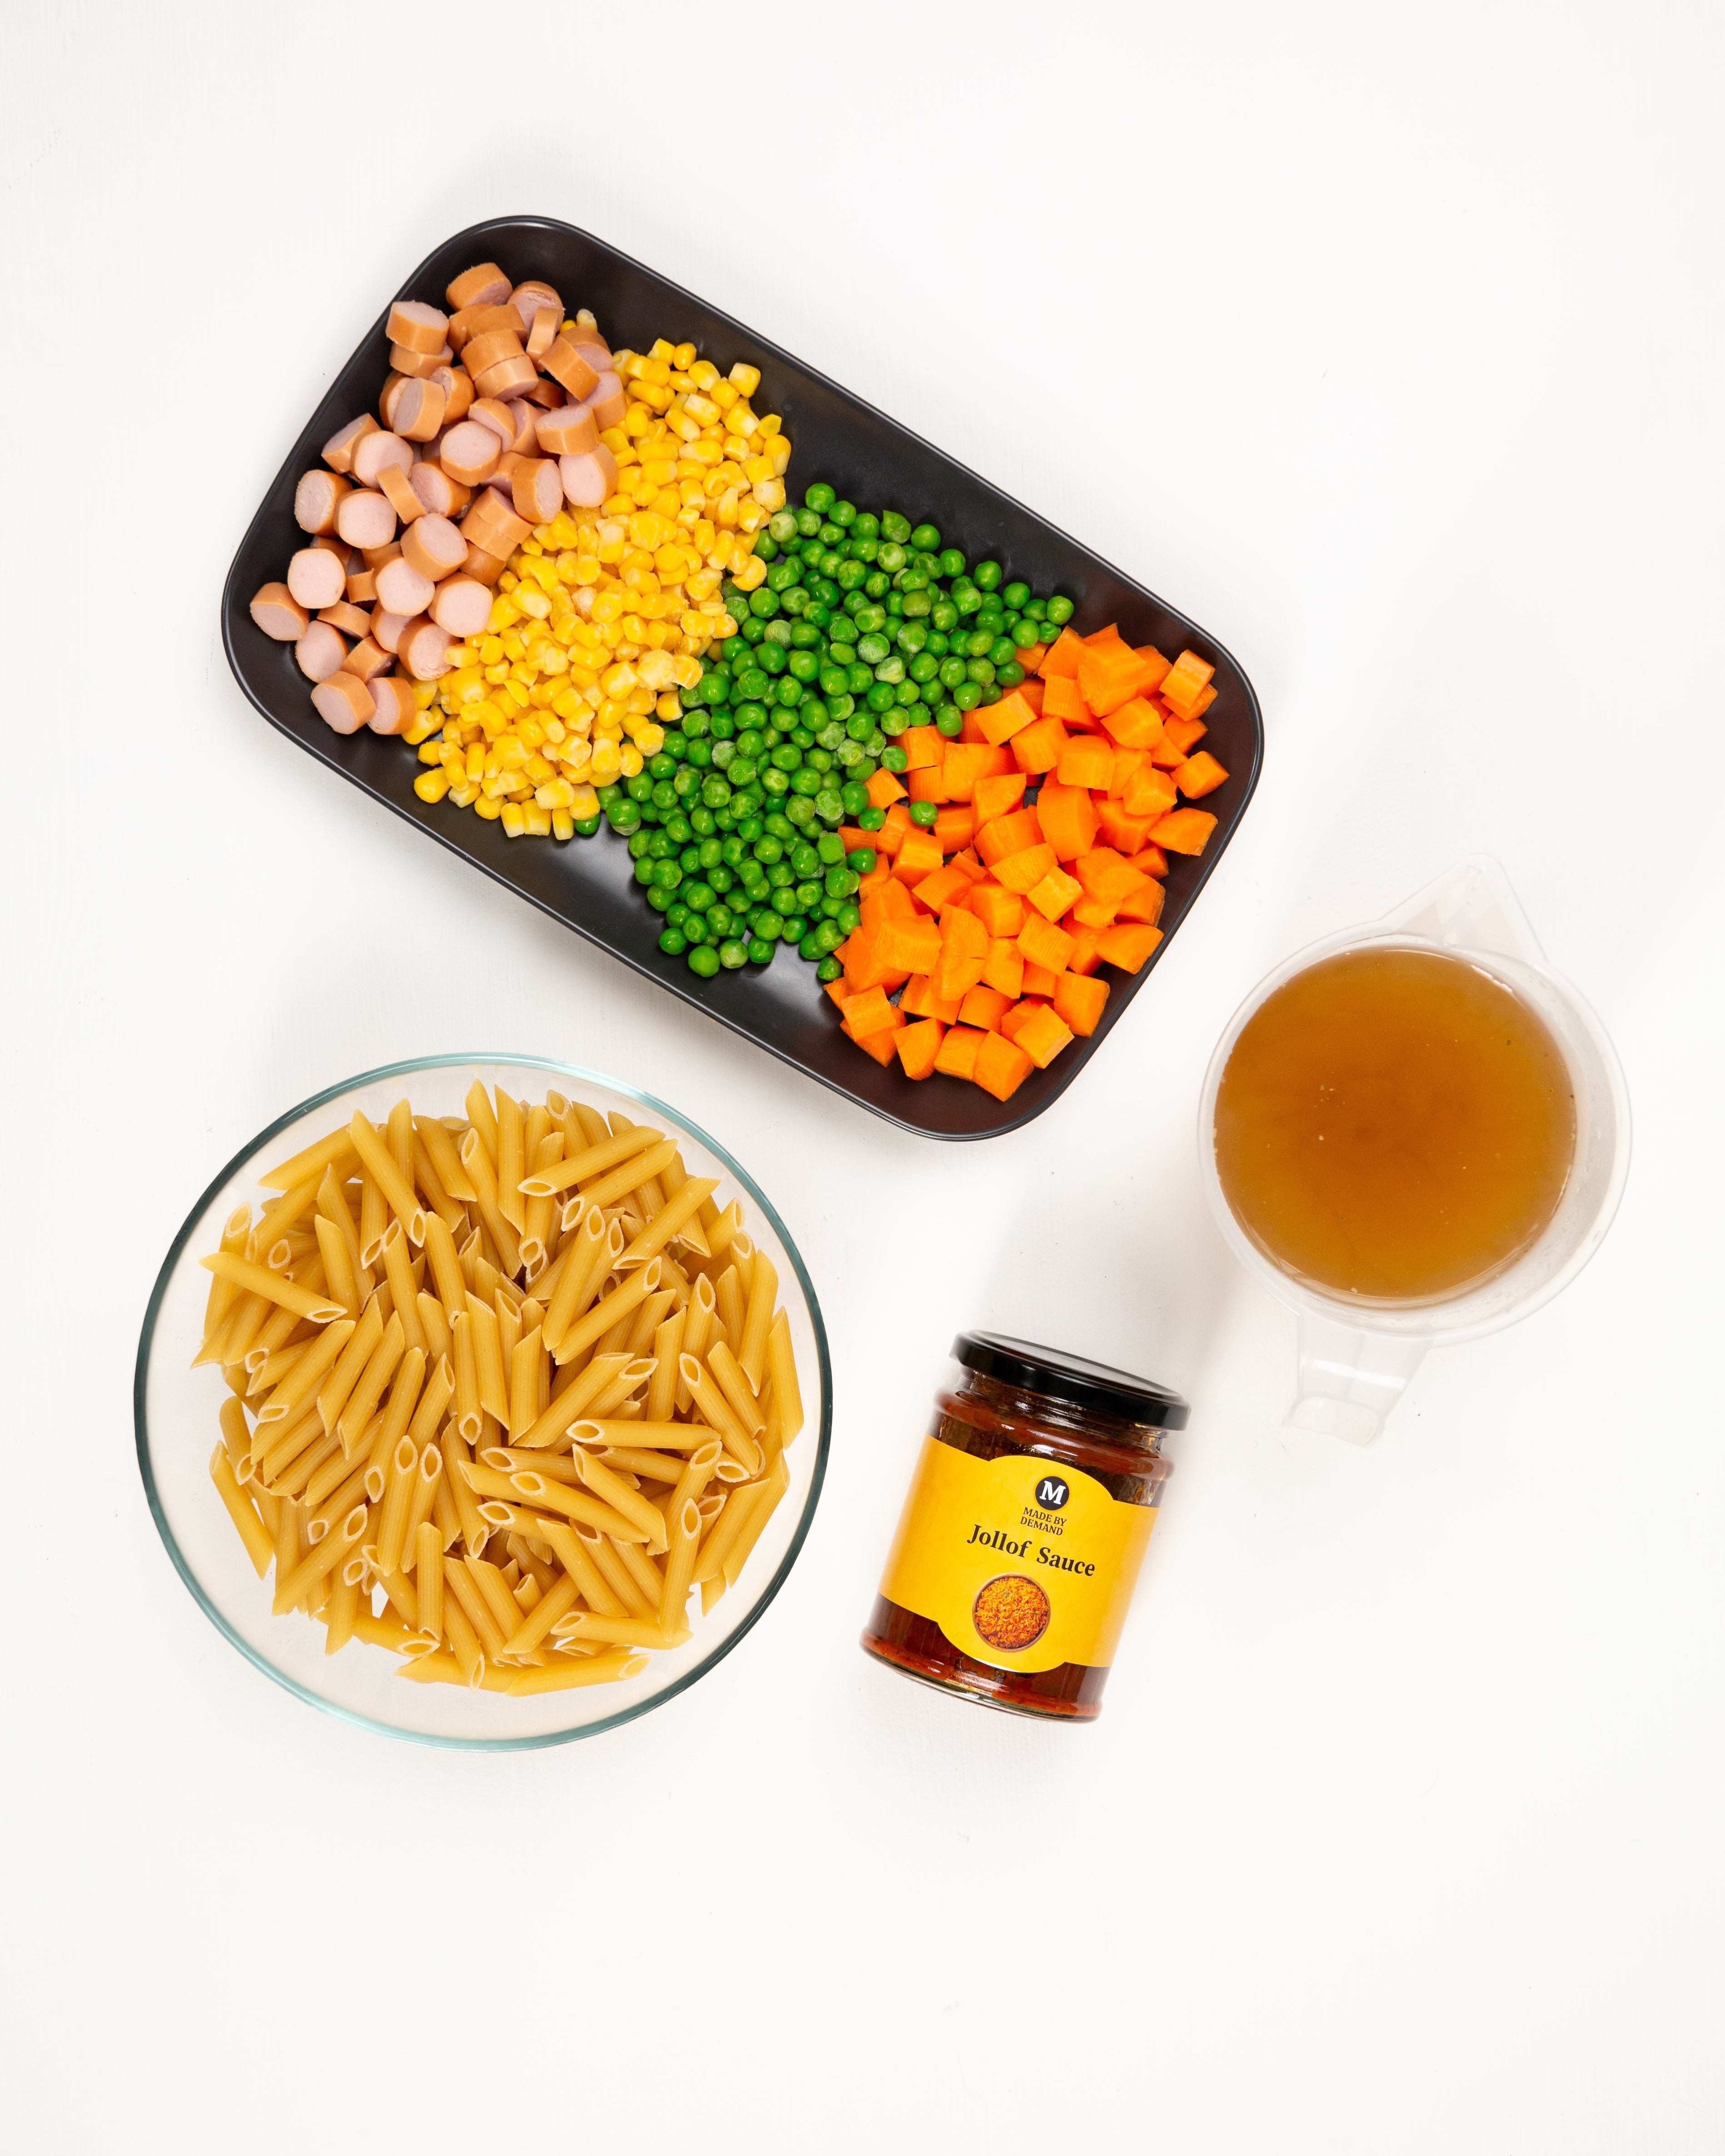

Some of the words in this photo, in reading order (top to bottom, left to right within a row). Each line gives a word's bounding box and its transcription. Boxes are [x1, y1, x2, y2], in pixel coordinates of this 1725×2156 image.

[1039, 1480, 1066, 1505] M
[1020, 1516, 1063, 1536] DEMAND
[1023, 1507, 1052, 1523] MADE
[1055, 1515, 1067, 1527] BY
[967, 1524, 1032, 1558] Jollof
[1036, 1547, 1095, 1577] Sauce
